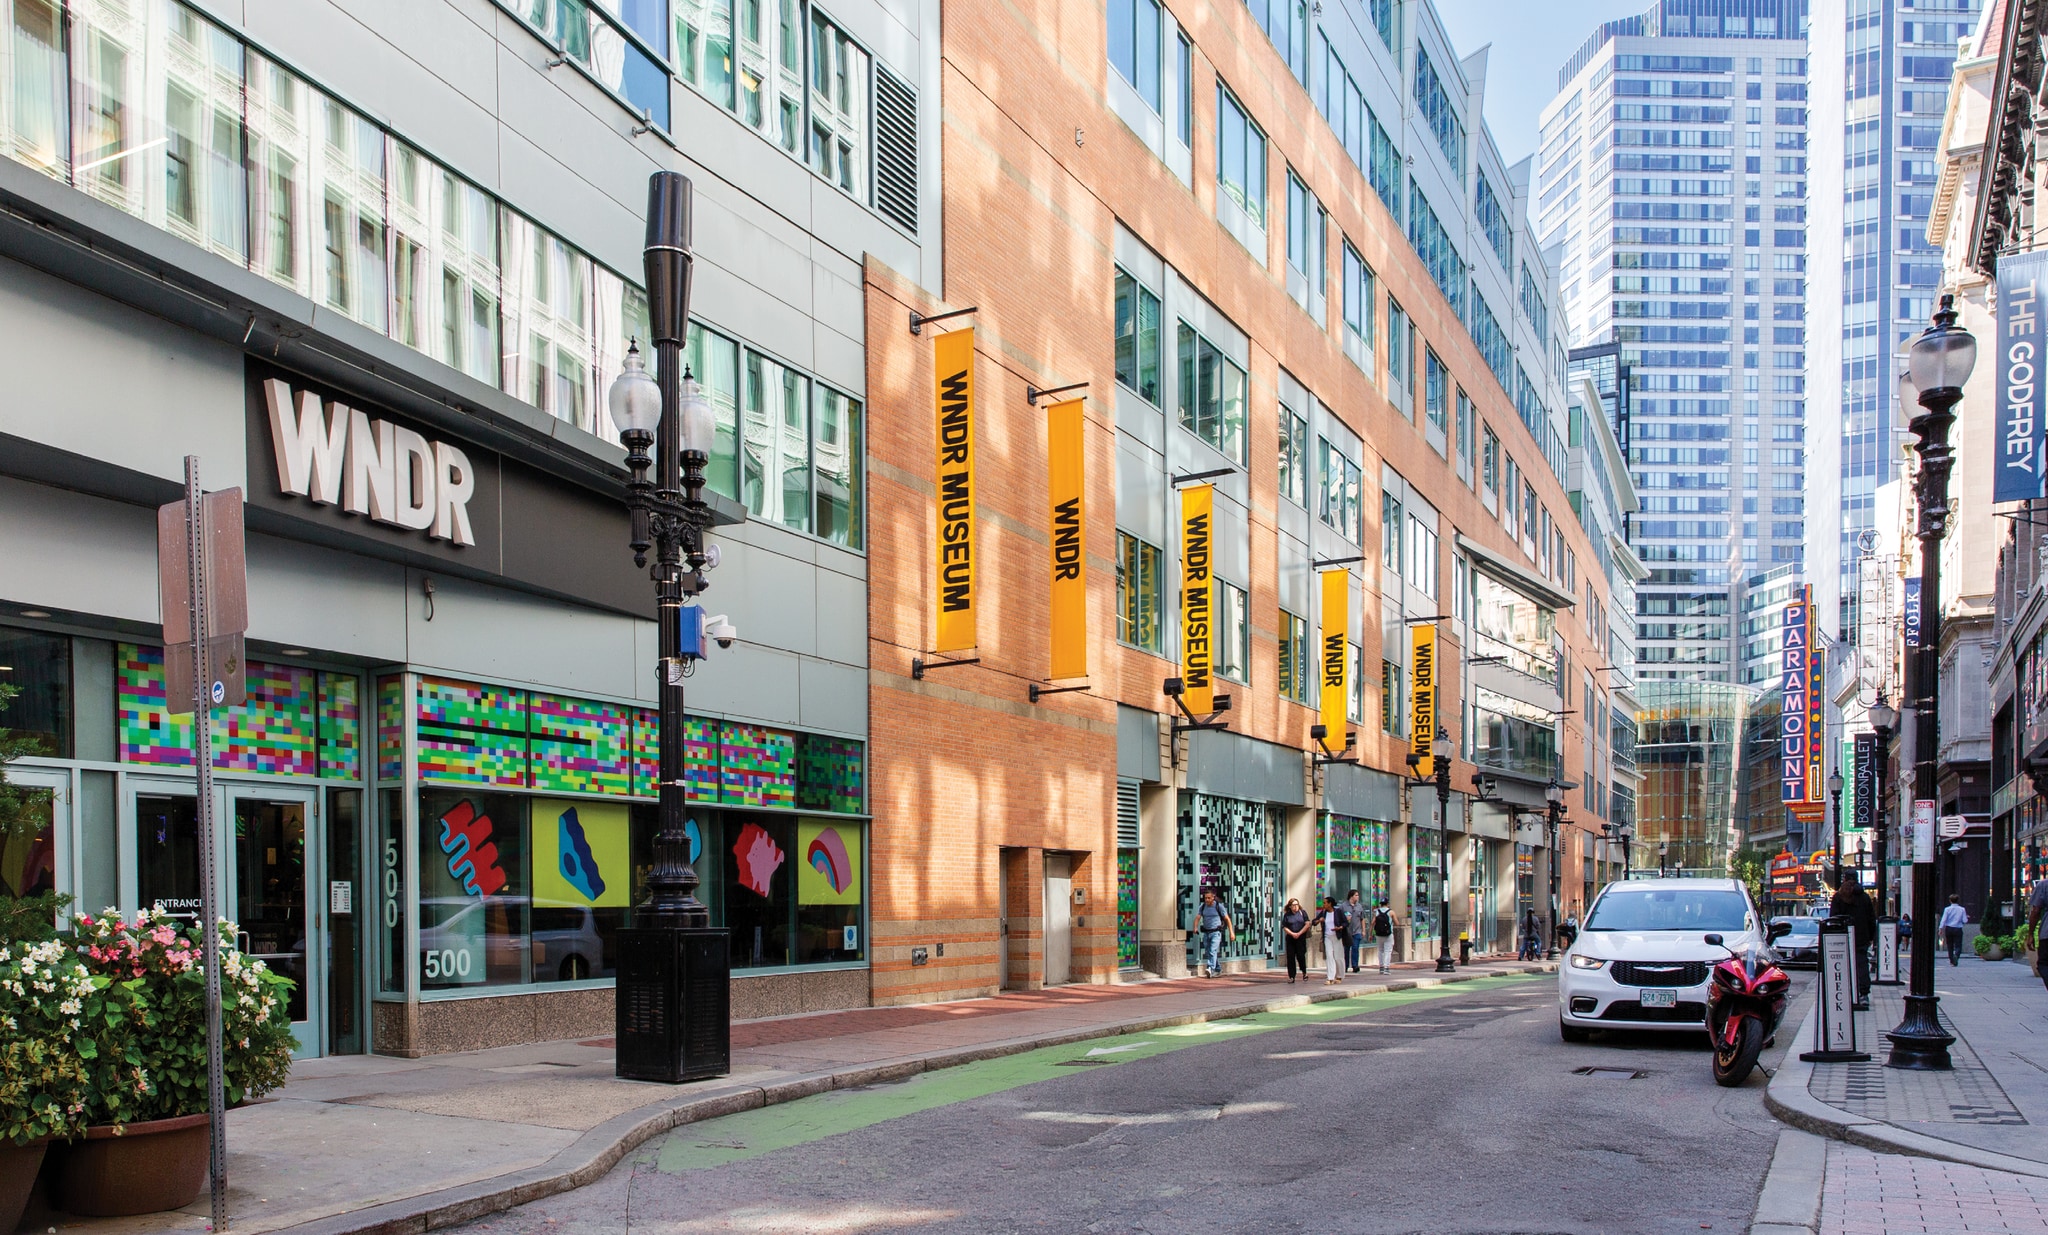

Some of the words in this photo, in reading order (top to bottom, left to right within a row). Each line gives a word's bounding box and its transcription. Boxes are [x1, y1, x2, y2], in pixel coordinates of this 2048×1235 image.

[2009, 279, 2036, 337] THE
[941, 369, 968, 465] WNDR
[2006, 341, 2035, 473] GODFREY
[264, 378, 475, 546] WNDR
[942, 471, 970, 613] MUSEUM
[1054, 496, 1080, 582] WNDR
[1186, 513, 1208, 582] WNDR
[1187, 586, 1208, 688] MUSEUM
[1906, 591, 1919, 647] FFOLK
[1325, 633, 1344, 687] WNDR
[1415, 643, 1432, 687] WNDR
[1414, 691, 1431, 757] MUSEUM
[1784, 606, 1803, 799] PARAMOUNT
[384, 838, 398, 928] 500
[425, 948, 471, 979] 500
[1883, 935, 1891, 971] VALET
[1833, 962, 1843, 1012] CHECK
[1837, 1022, 1844, 1041] IN
